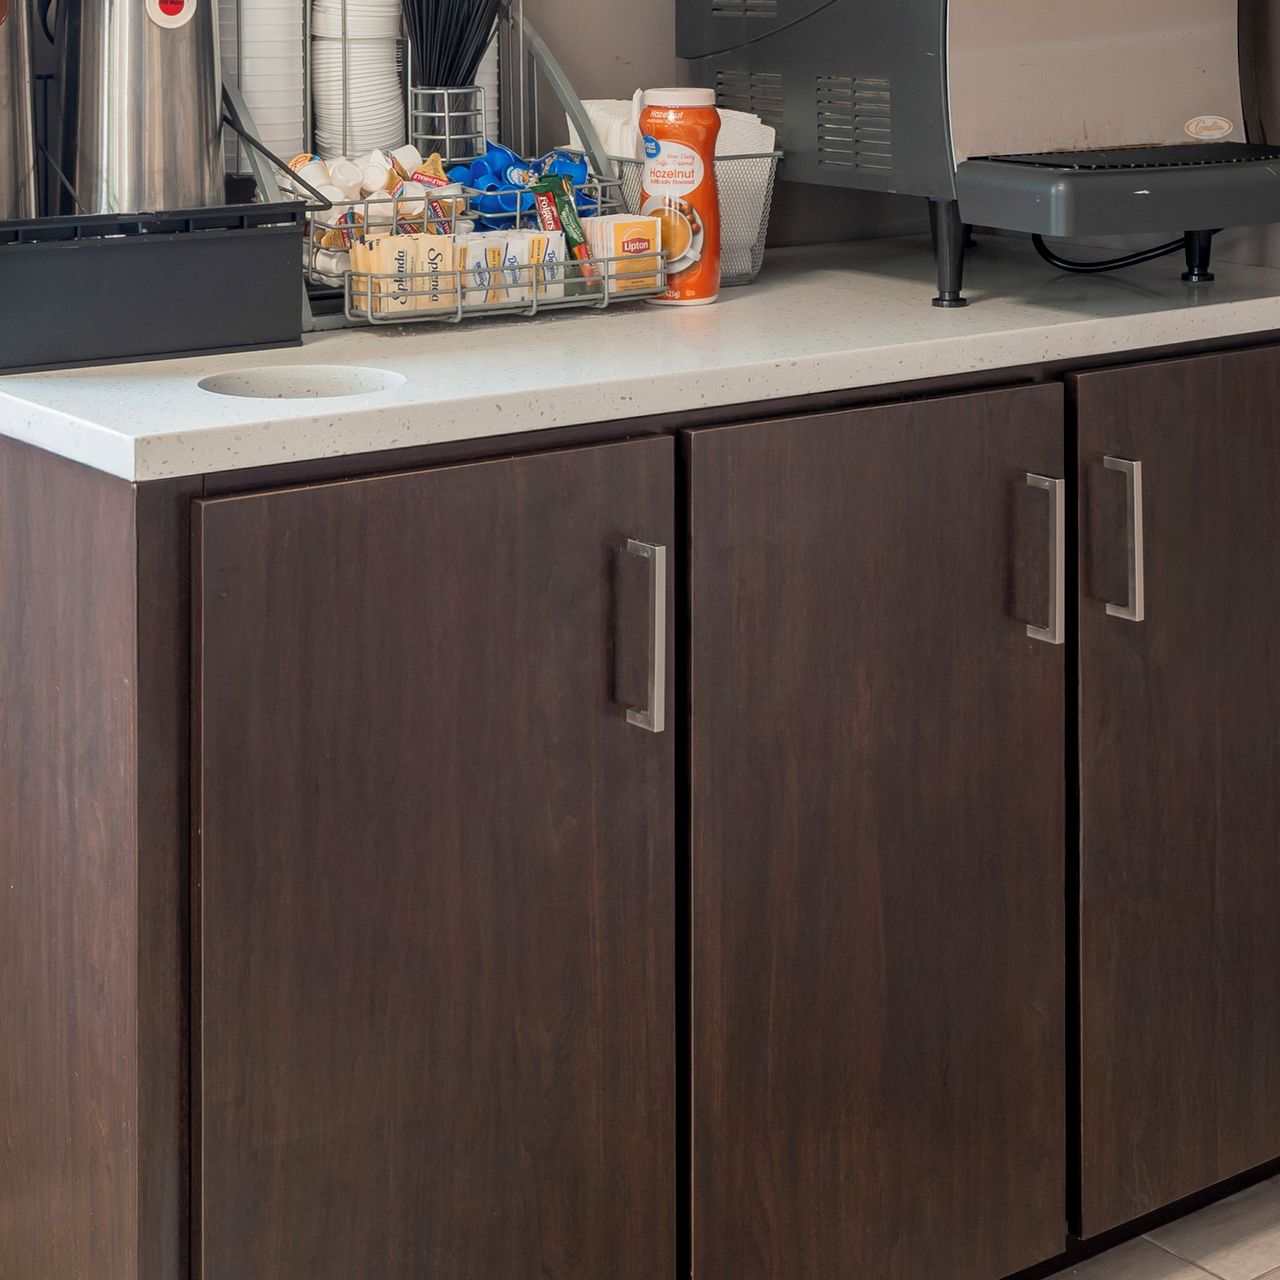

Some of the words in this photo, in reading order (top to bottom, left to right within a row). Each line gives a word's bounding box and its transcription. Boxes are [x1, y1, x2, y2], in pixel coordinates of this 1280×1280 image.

[650, 109, 684, 118] Hazeut
[650, 168, 695, 179] Hazelnut
[538, 196, 555, 230] Folgers
[624, 241, 649, 252] Lipton
[392, 250, 408, 305] Splnda
